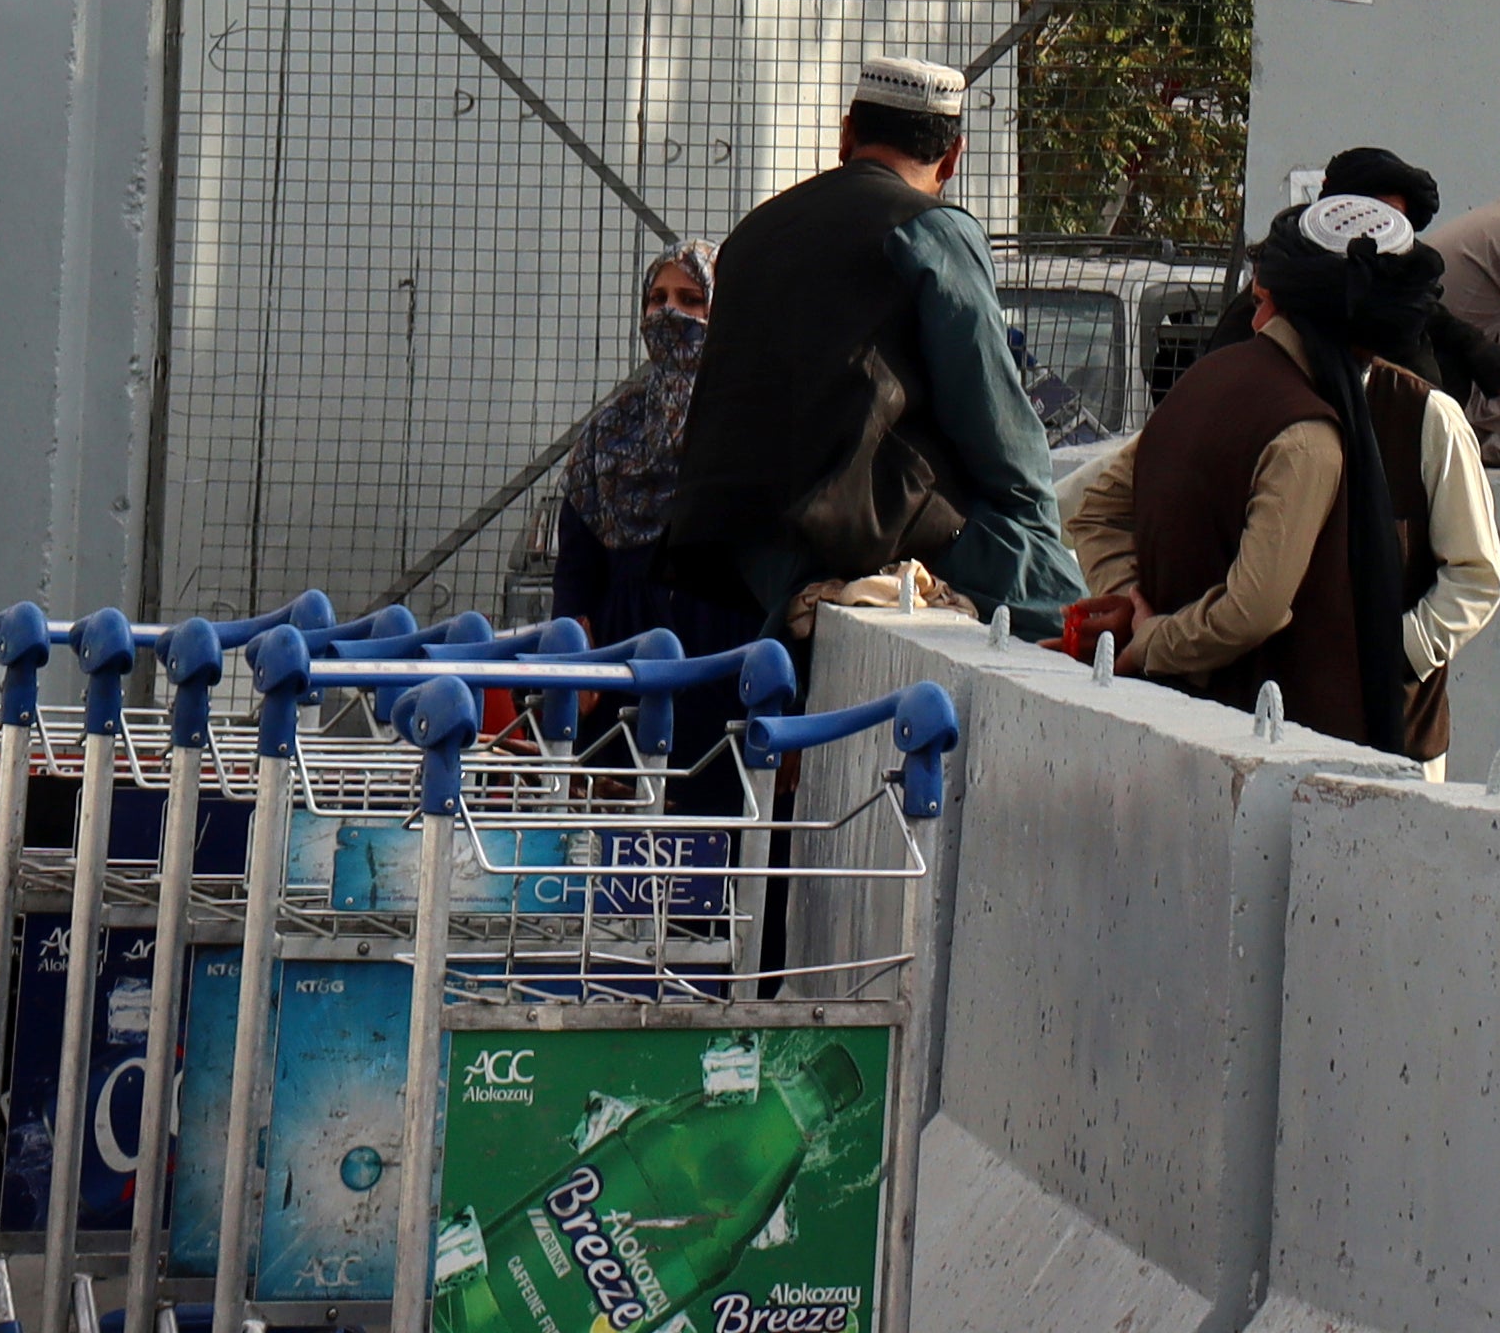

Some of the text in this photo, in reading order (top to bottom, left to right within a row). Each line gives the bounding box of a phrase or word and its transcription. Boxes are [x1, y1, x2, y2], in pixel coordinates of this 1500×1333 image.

[611, 835, 696, 869] ESSE
[295, 978, 345, 994] KT&G
[463, 1049, 536, 1086] AGC
[462, 1085, 535, 1107] Alokozay
[541, 1231, 569, 1274] DRINK
[546, 1167, 645, 1327] Breeze
[601, 1209, 671, 1322] Alokozay
[507, 1255, 547, 1319] CAFFEINE
[768, 1282, 862, 1308] Alokozay
[712, 1294, 847, 1333] Breeze
